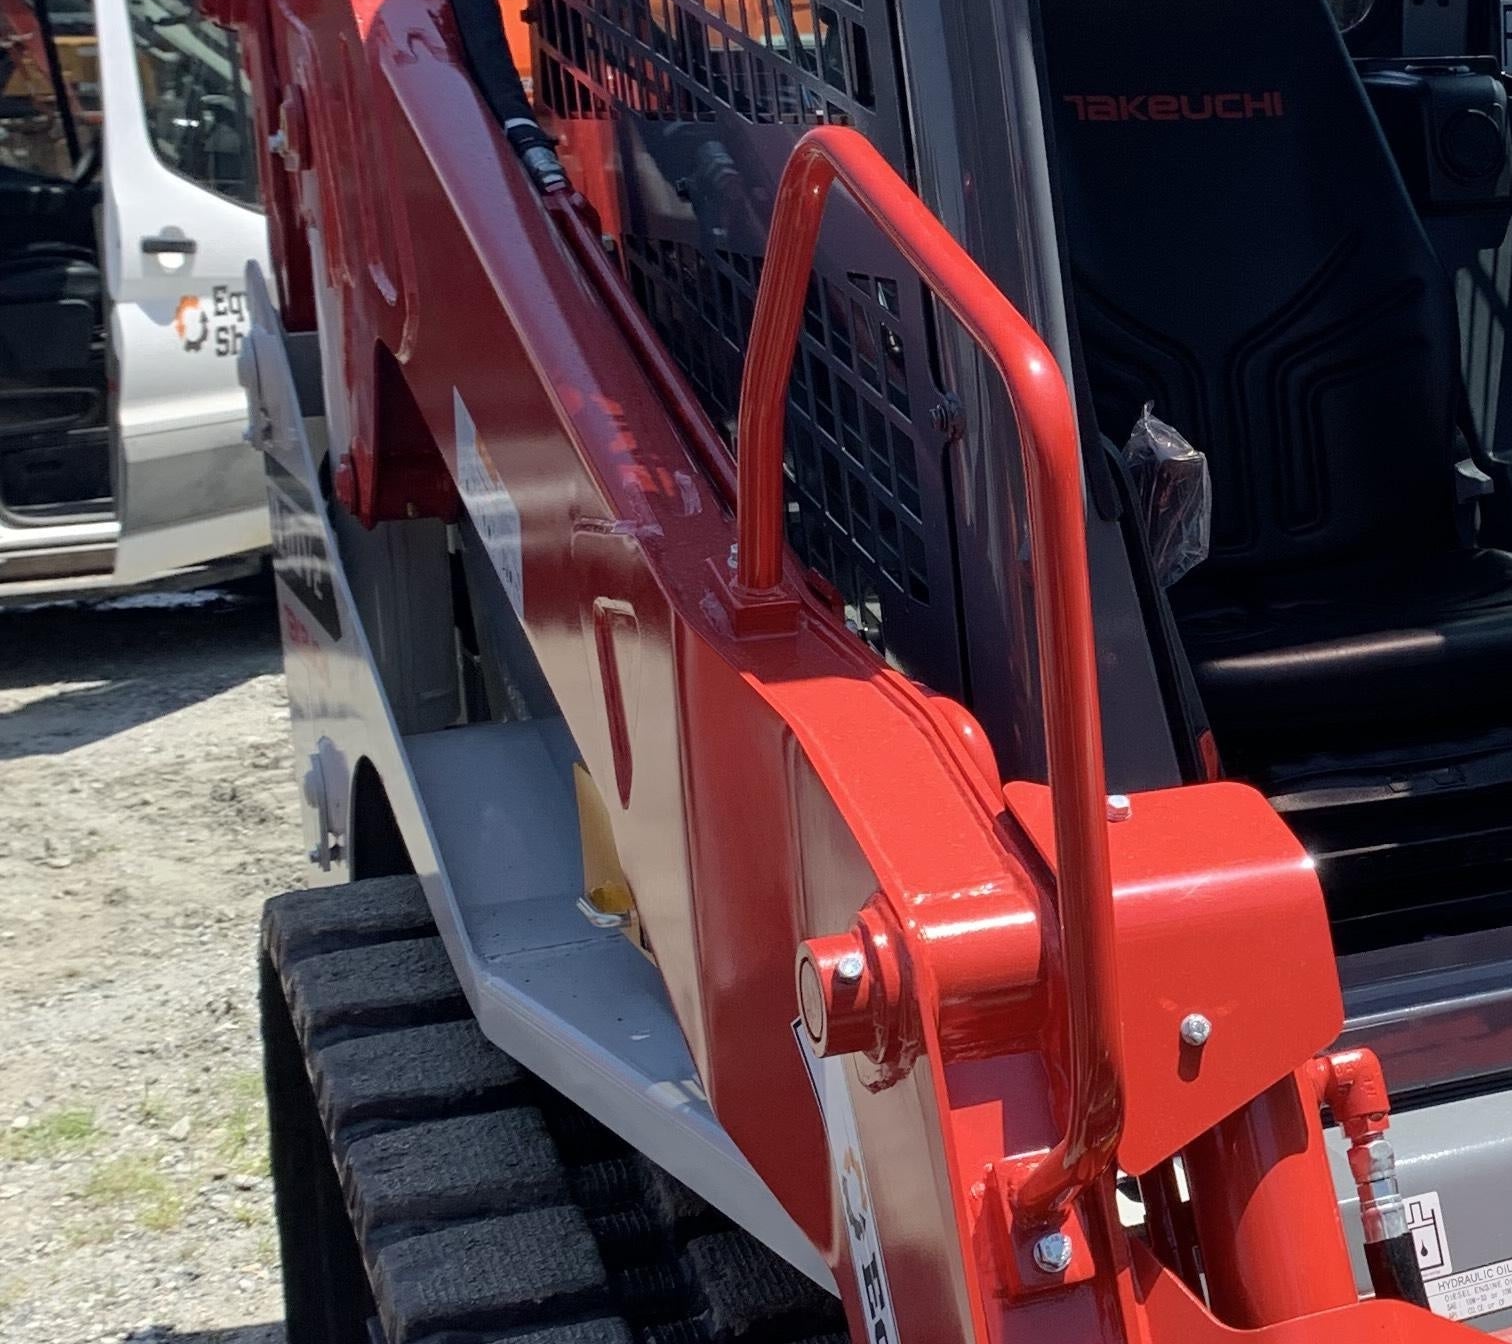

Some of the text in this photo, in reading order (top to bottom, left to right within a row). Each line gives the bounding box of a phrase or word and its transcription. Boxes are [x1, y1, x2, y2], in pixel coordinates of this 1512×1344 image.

[1437, 1263, 1512, 1291] HYDRAULIC OIL
[1444, 1289, 1472, 1303] DIESEL
